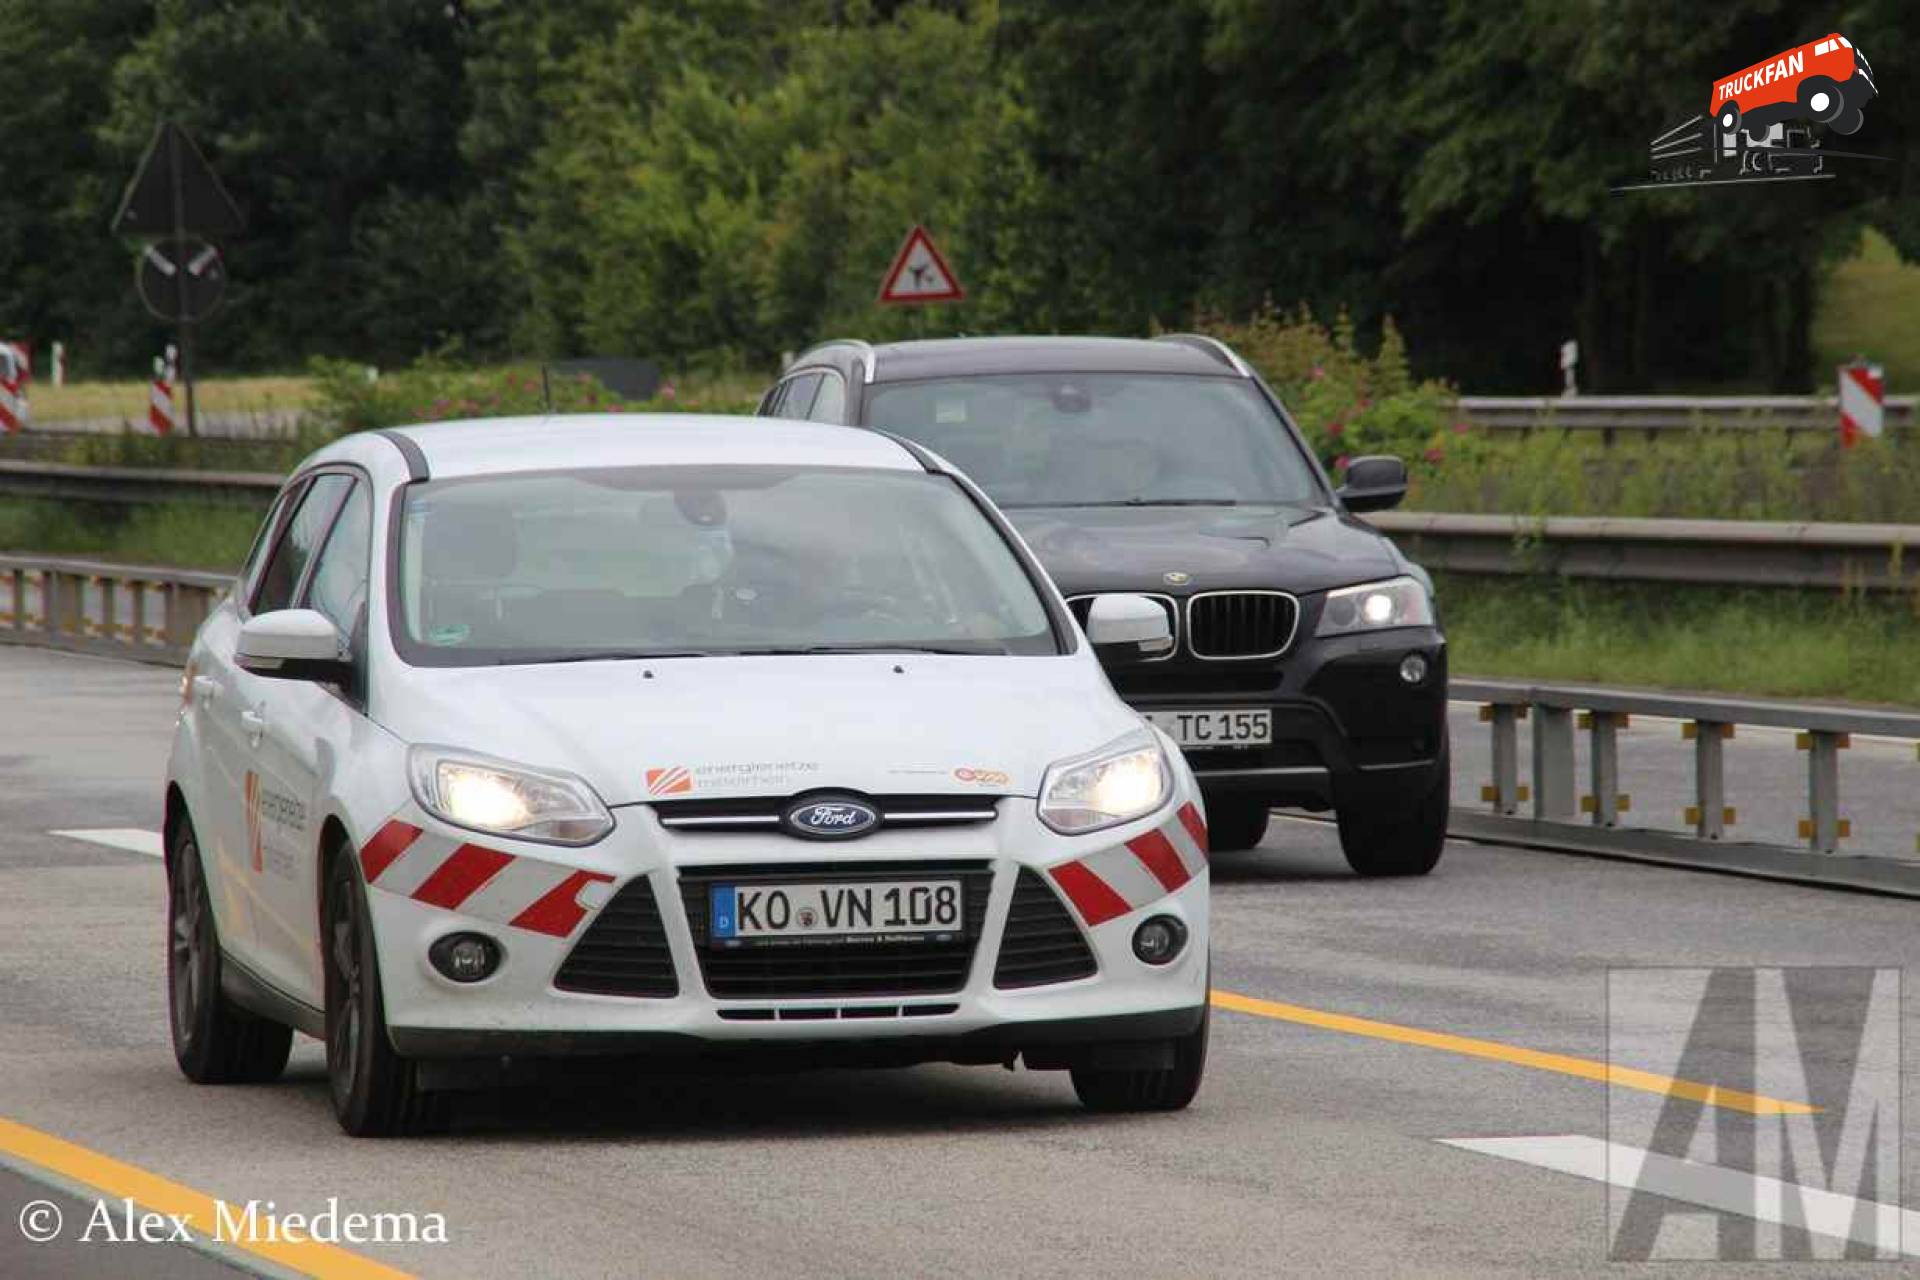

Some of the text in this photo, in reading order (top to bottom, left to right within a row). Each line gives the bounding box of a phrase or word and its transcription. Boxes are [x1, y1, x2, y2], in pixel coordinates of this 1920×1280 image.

[1176, 713, 1269, 741] TC 155
[811, 806, 857, 825] Ford
[737, 885, 957, 931] KO VN 108
